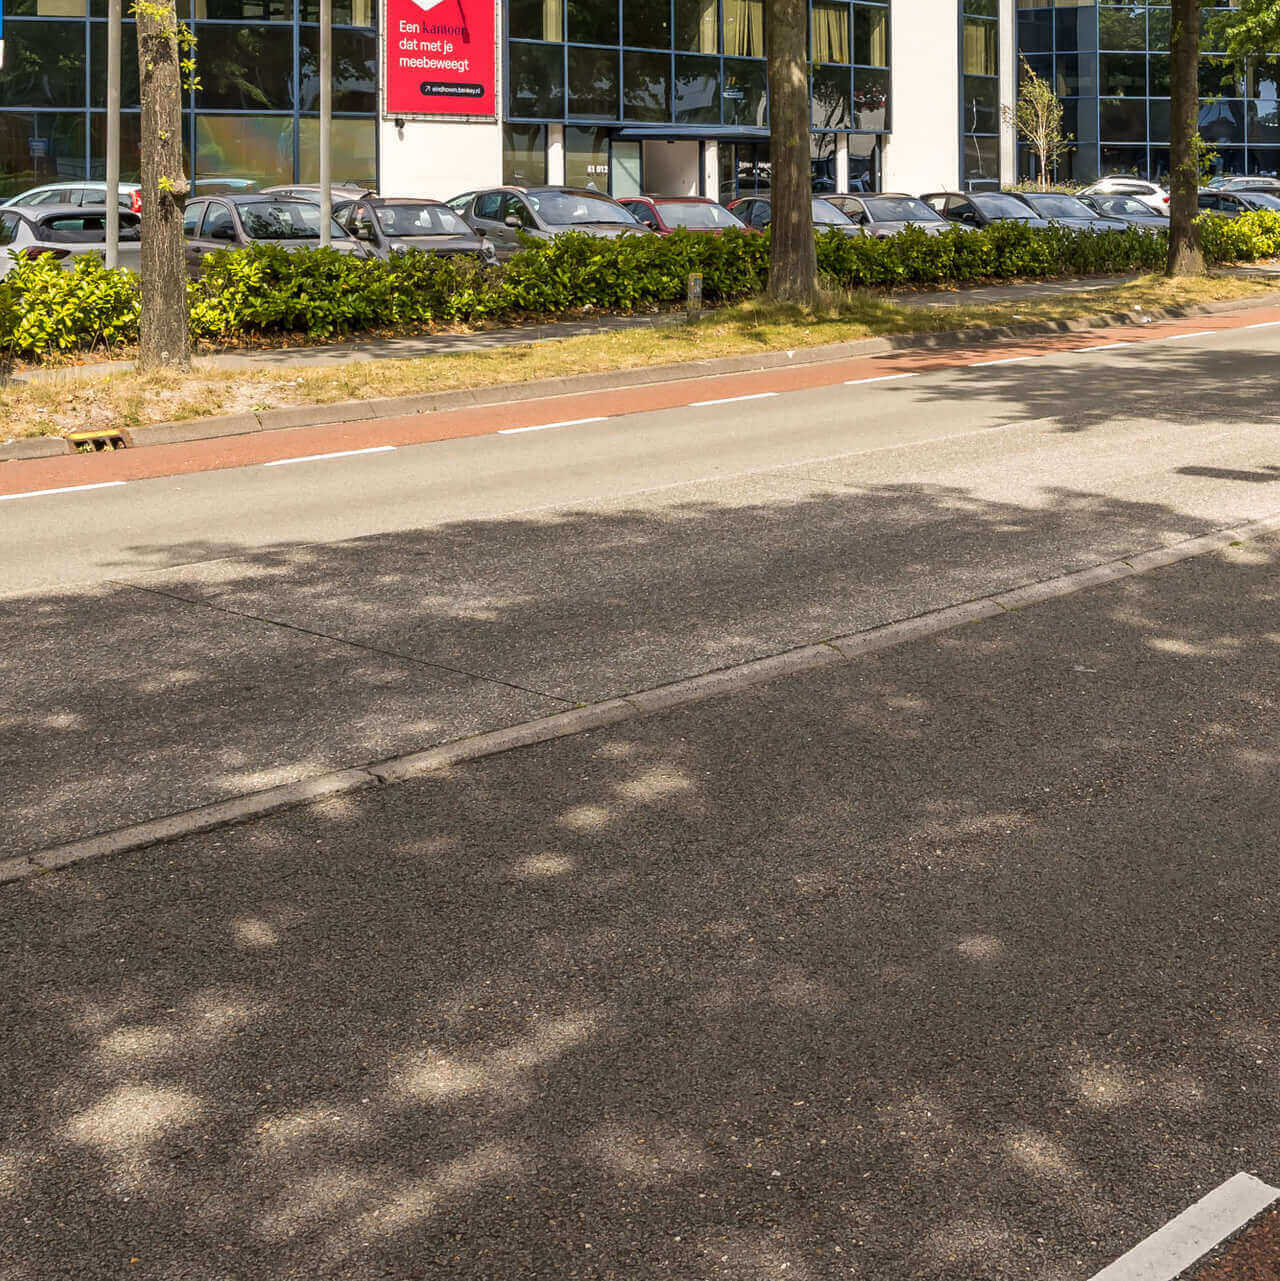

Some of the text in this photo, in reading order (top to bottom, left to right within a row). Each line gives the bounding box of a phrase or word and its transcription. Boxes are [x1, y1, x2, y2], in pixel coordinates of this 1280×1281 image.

[399, 20, 467, 36] Een kantoor
[399, 37, 454, 55] dat met je
[399, 56, 469, 72] meebeweegt
